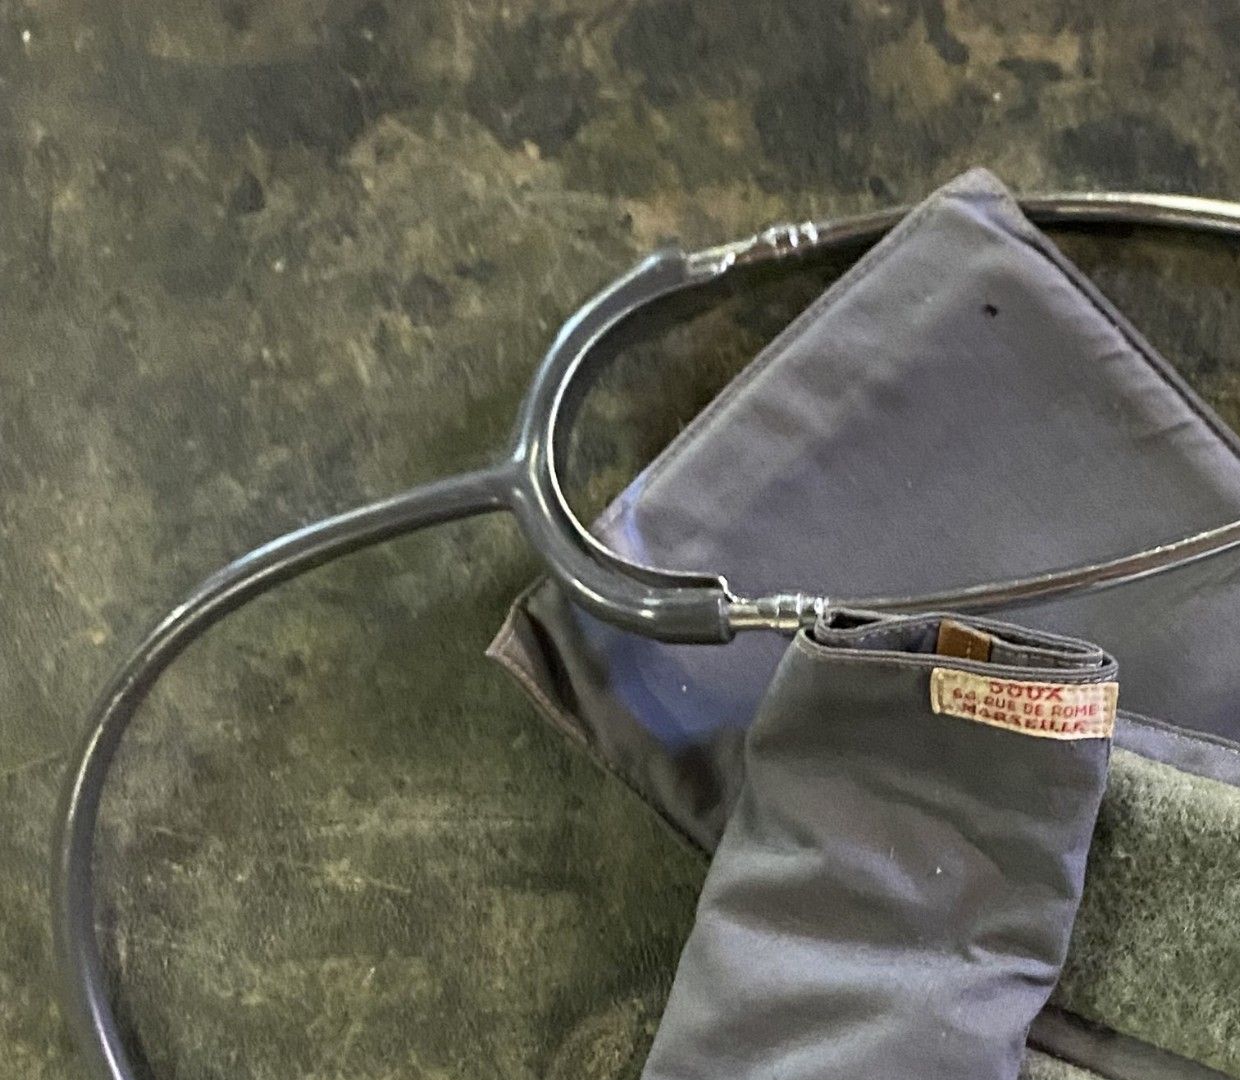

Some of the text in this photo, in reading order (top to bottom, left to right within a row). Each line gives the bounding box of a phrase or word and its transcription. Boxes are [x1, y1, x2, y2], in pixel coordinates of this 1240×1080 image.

[983, 695, 1016, 711] RUE
[1024, 702, 1045, 717] DE
[1051, 703, 1099, 719] ROME
